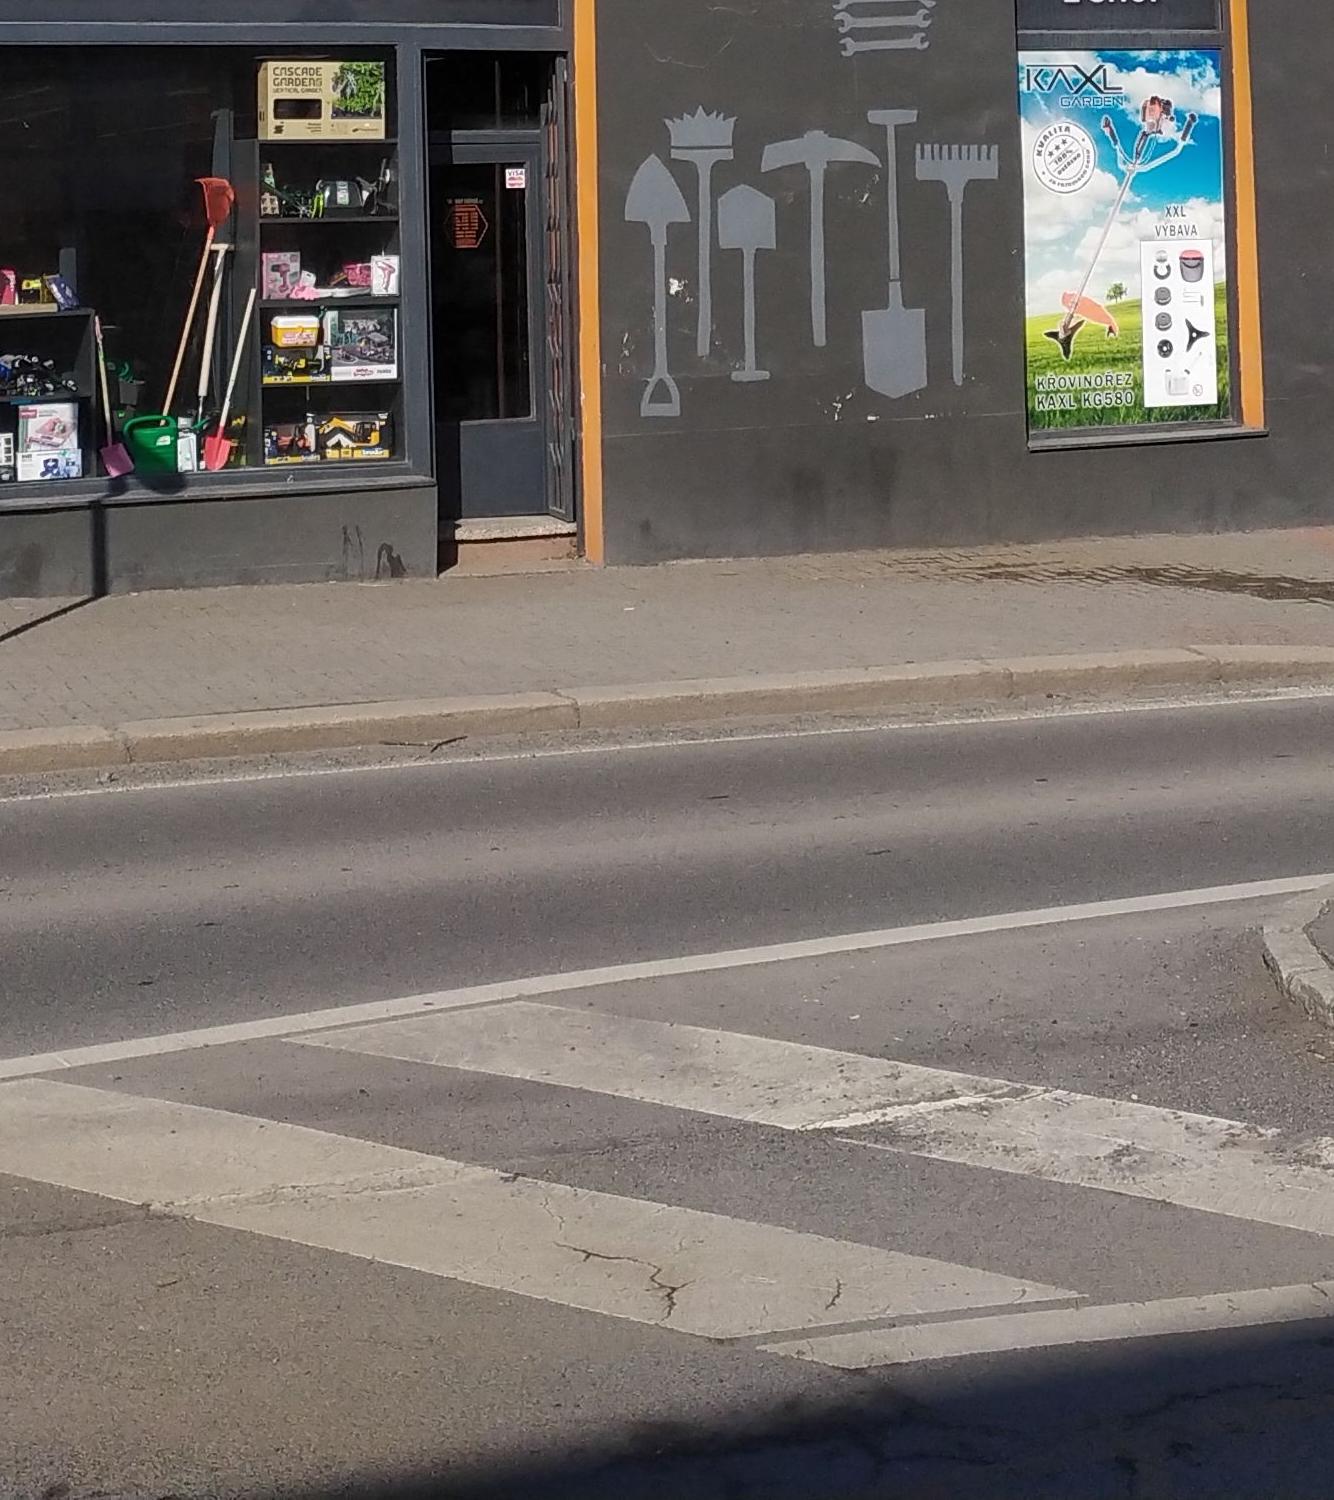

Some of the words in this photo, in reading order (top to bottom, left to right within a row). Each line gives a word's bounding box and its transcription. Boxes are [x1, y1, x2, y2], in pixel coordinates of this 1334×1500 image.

[272, 66, 322, 76] CASCADE
[1026, 64, 1124, 95] KAXL
[1060, 96, 1124, 107] GARDEN
[1036, 125, 1071, 157] KVALITA
[1165, 205, 1187, 218] XXL
[1037, 372, 1133, 390] KŘOVINOŘEZ
[1037, 393, 1076, 409] KAXL
[1083, 391, 1133, 406] KG580
